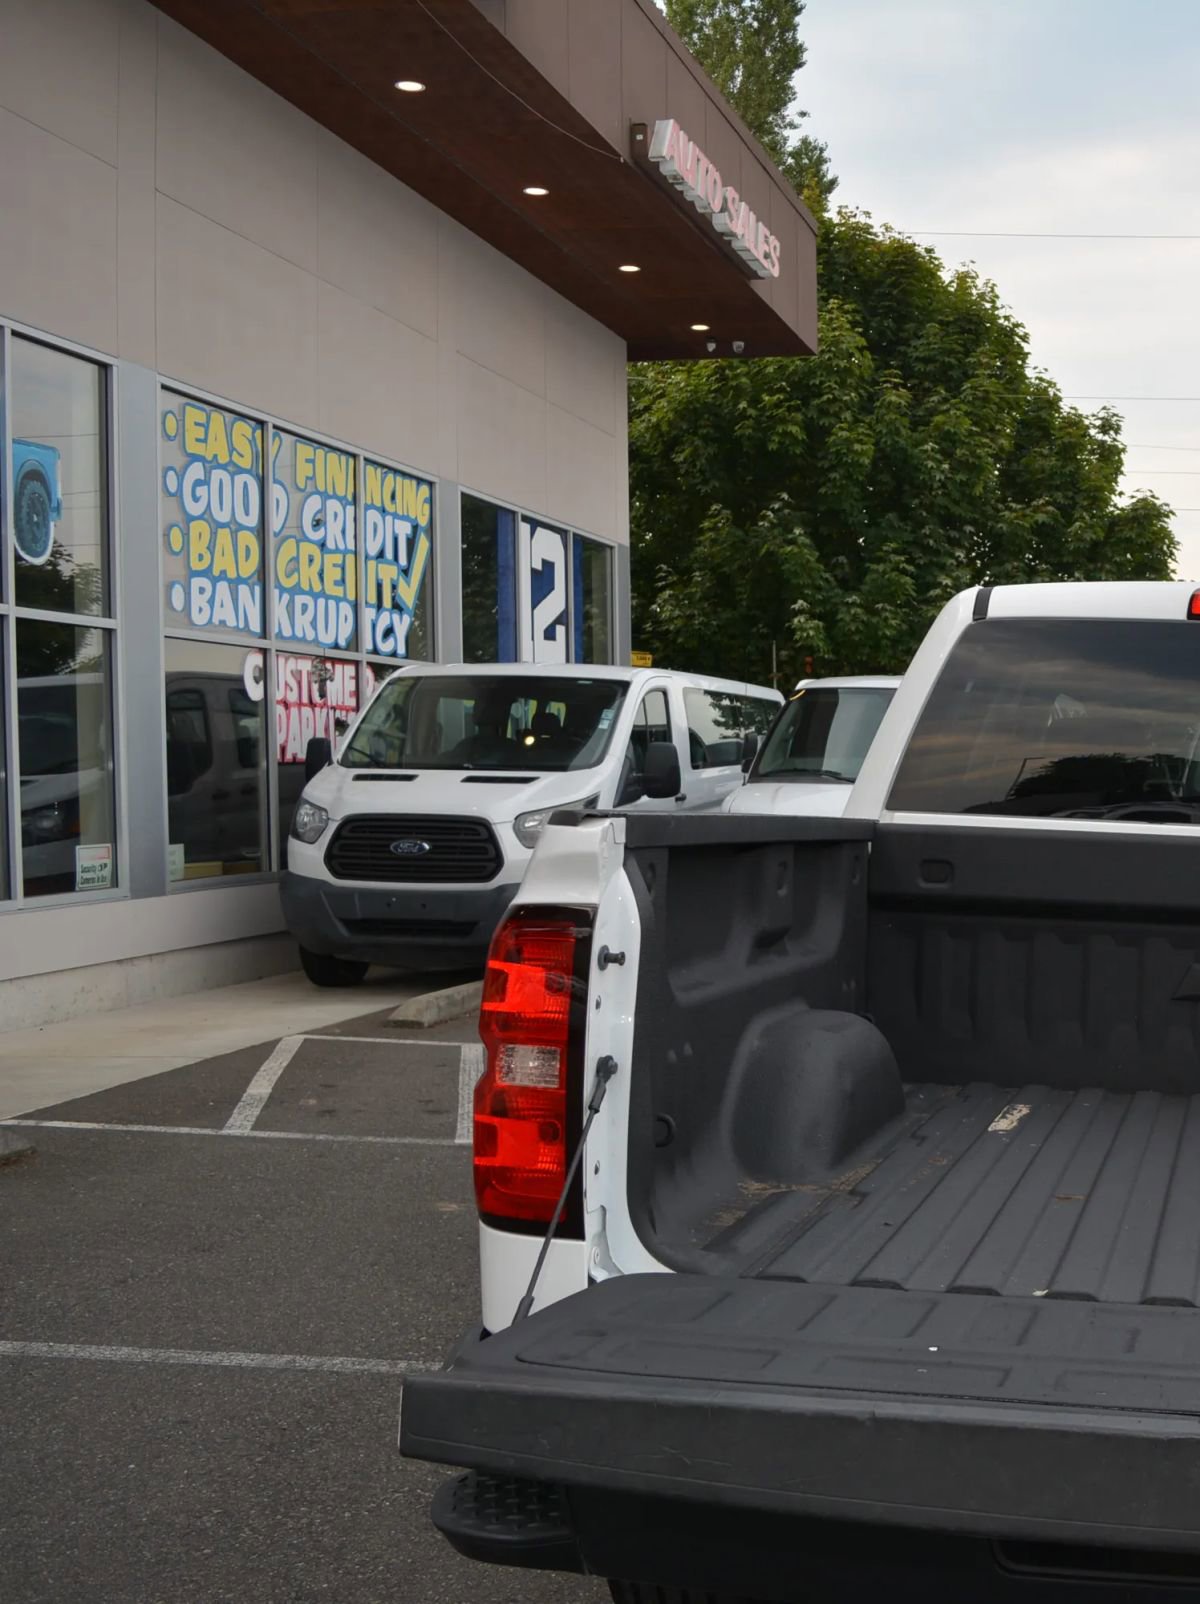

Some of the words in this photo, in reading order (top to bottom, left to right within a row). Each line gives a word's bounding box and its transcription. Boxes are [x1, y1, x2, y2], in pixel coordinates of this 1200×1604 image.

[657, 119, 723, 213] AUTO
[722, 186, 781, 278] SALES
[183, 403, 281, 476] EASY
[182, 462, 288, 536] GOOD
[189, 521, 260, 579] BAD
[191, 577, 410, 656] BANKRUPTCY
[521, 522, 566, 664] 12
[244, 651, 375, 708] CUSTOMER
[276, 705, 364, 762] PARKI
[397, 841, 424, 854] Ford
